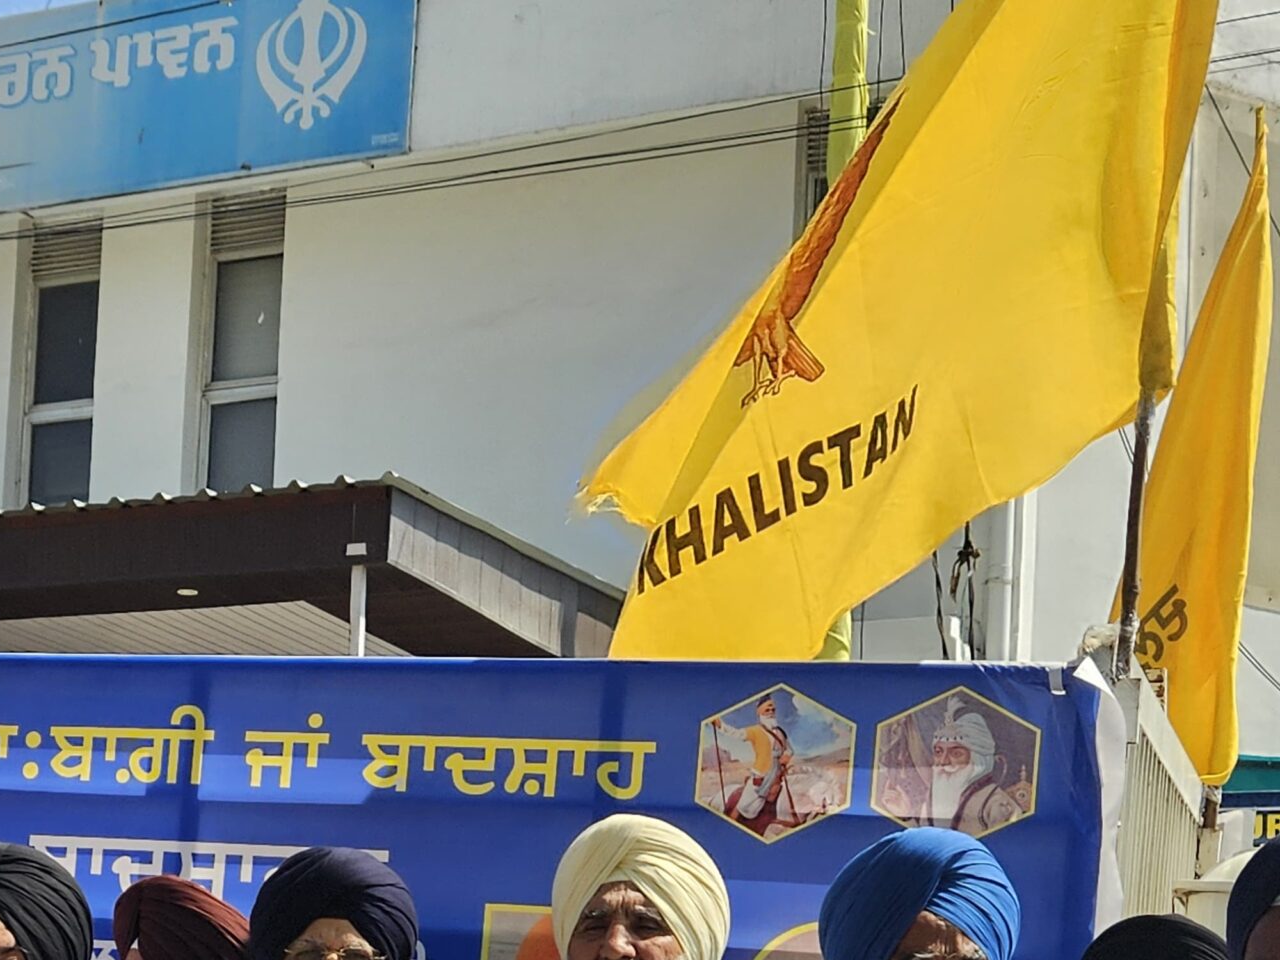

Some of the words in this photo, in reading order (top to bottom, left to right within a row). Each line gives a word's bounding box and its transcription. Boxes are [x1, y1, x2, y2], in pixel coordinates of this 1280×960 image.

[89, 16, 239, 88] ਪਾਵਨ
[637, 384, 918, 595] KHALISTAN
[245, 713, 330, 789] ਜਾਂ
[362, 734, 657, 801] ਬਾਦਸ਼ਾਹ
